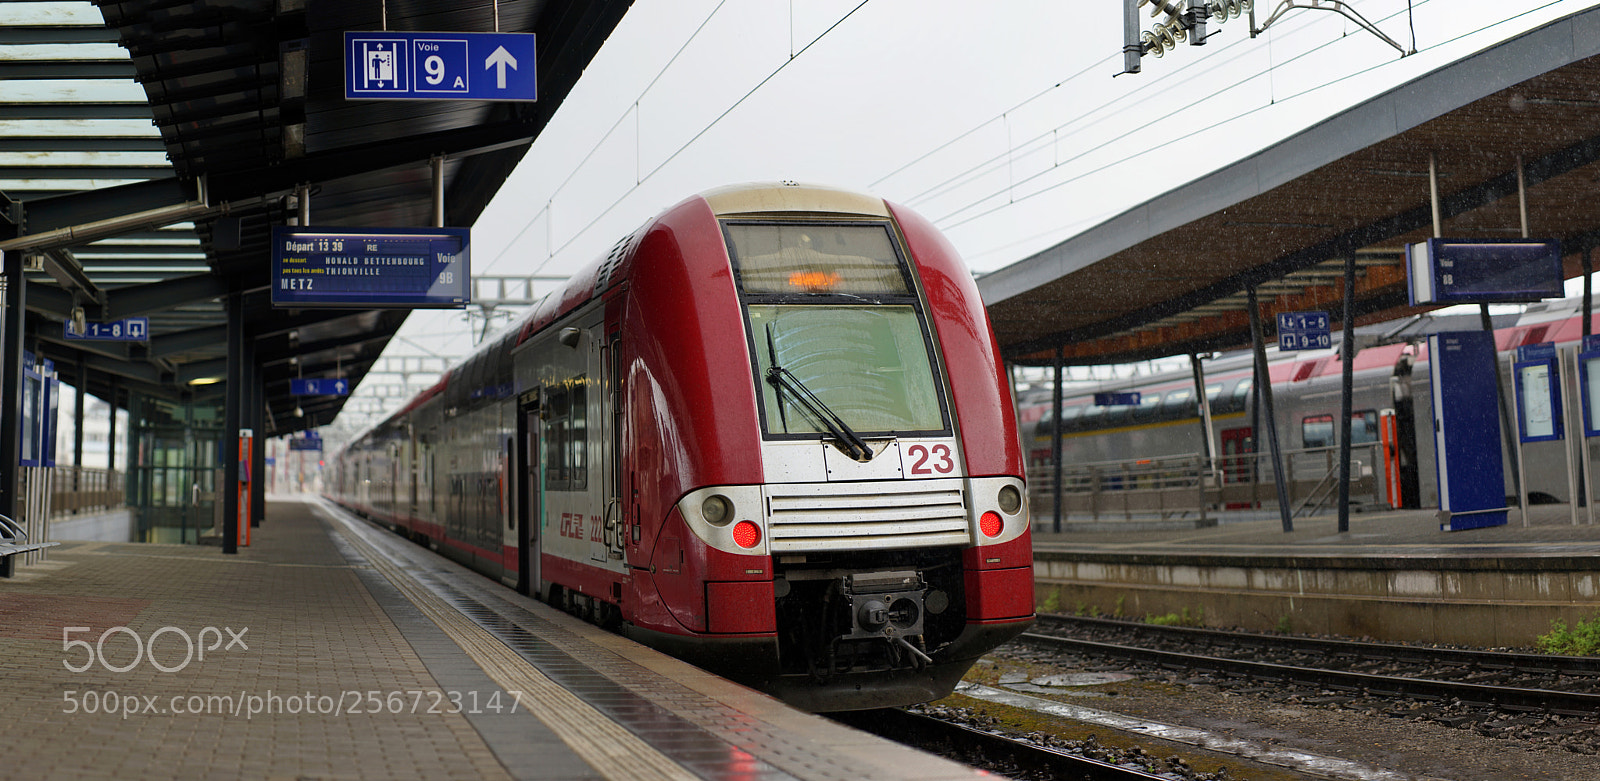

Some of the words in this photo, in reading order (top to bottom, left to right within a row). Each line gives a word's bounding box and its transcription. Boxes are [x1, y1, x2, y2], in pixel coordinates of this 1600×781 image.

[417, 43, 440, 51] Voie
[424, 55, 445, 85] 9
[453, 76, 465, 88] A
[286, 241, 314, 253] Départ
[318, 242, 329, 252] 13
[332, 242, 344, 252] 39
[366, 244, 378, 252] RE
[437, 252, 456, 263] Voie
[325, 267, 380, 275] THIONVILLE
[281, 278, 313, 290] METZ
[439, 272, 453, 284] 9B
[908, 443, 954, 475] 23
